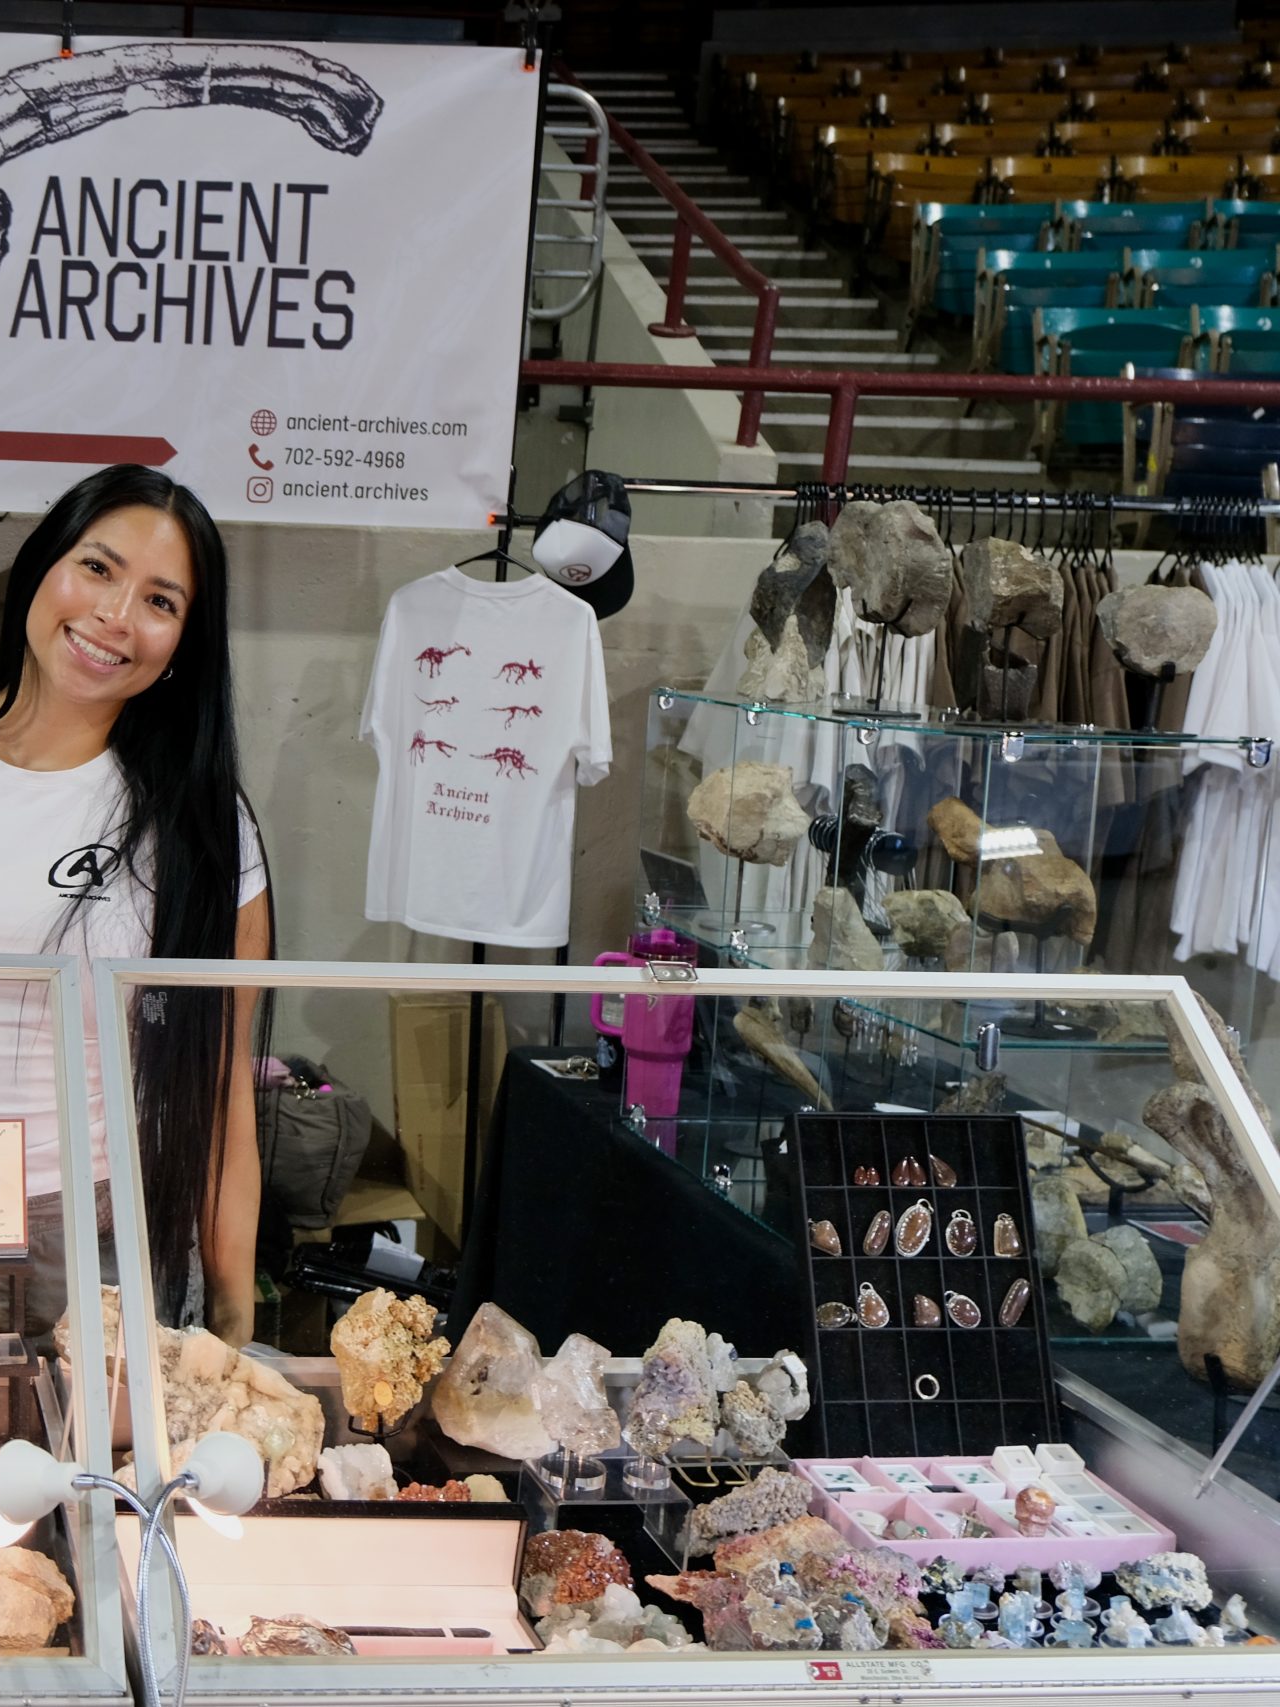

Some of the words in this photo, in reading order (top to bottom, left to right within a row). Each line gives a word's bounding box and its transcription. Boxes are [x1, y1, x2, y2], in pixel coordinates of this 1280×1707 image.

[30, 176, 329, 265] ANCIENT
[9, 258, 355, 350] ARCHIVES
[286, 413, 468, 436] ancient-archives.com
[284, 447, 405, 469] 702-592-4968
[282, 480, 429, 501] ancient.archives
[433, 782, 489, 803] Ancient
[426, 801, 491, 825] Archives
